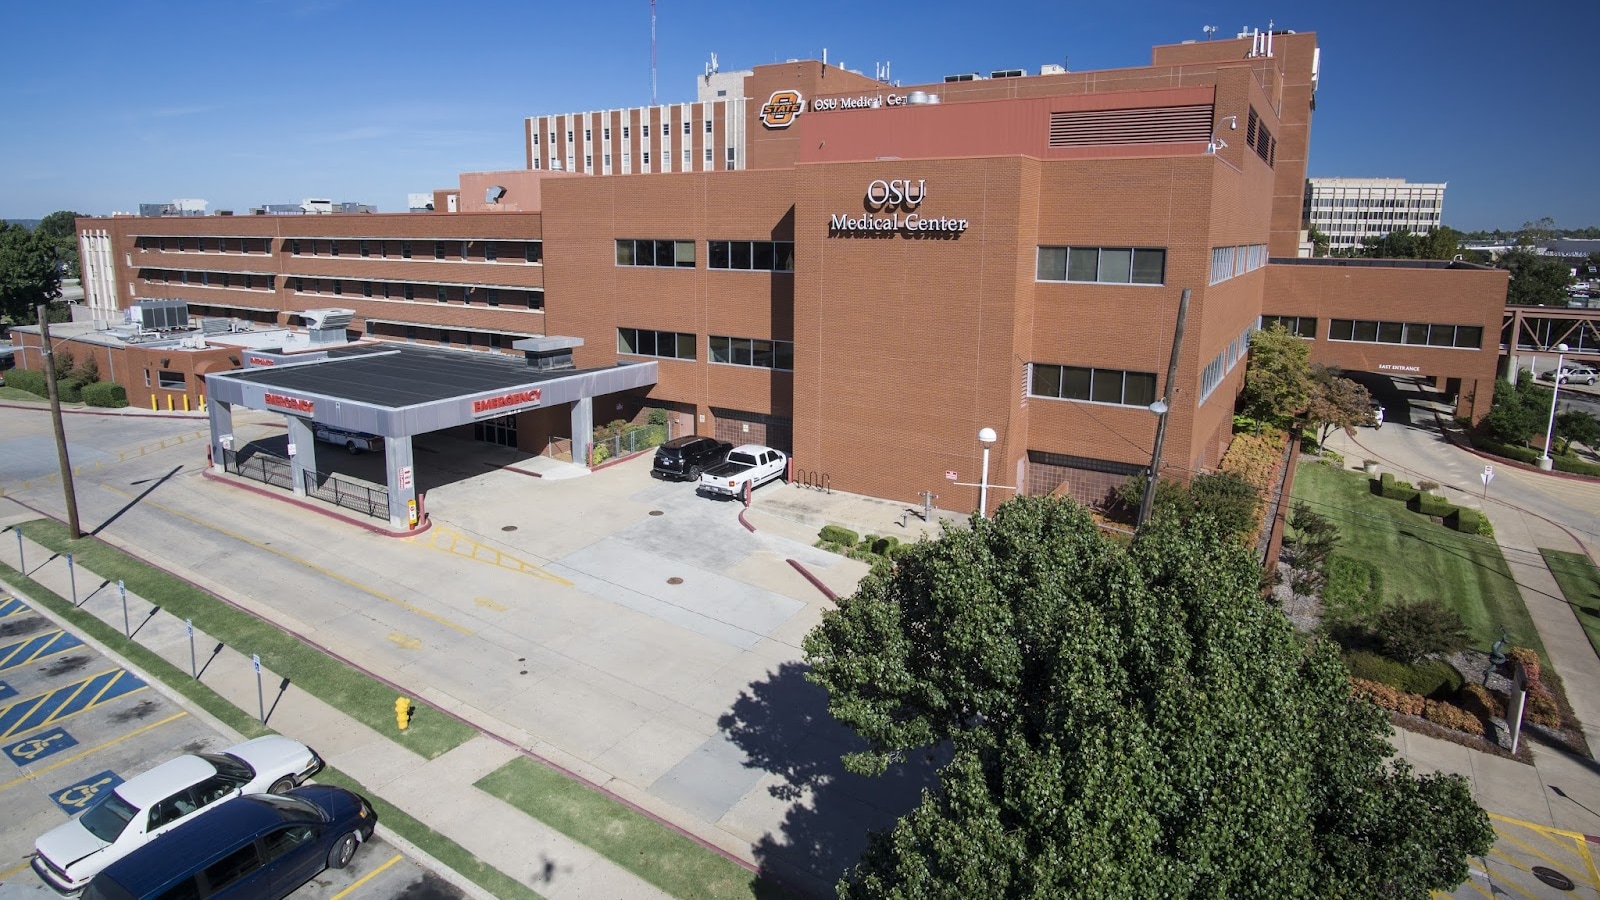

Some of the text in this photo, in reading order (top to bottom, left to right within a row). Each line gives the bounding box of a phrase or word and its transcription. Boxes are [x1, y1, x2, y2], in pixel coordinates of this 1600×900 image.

[764, 104, 799, 114] STATE
[815, 98, 837, 109] OSU
[887, 94, 908, 106] Cen
[868, 179, 925, 204] OSU
[831, 213, 967, 231] Medical Center
[264, 392, 314, 412] EMERGENCY
[473, 389, 542, 413] EMERGENCY
